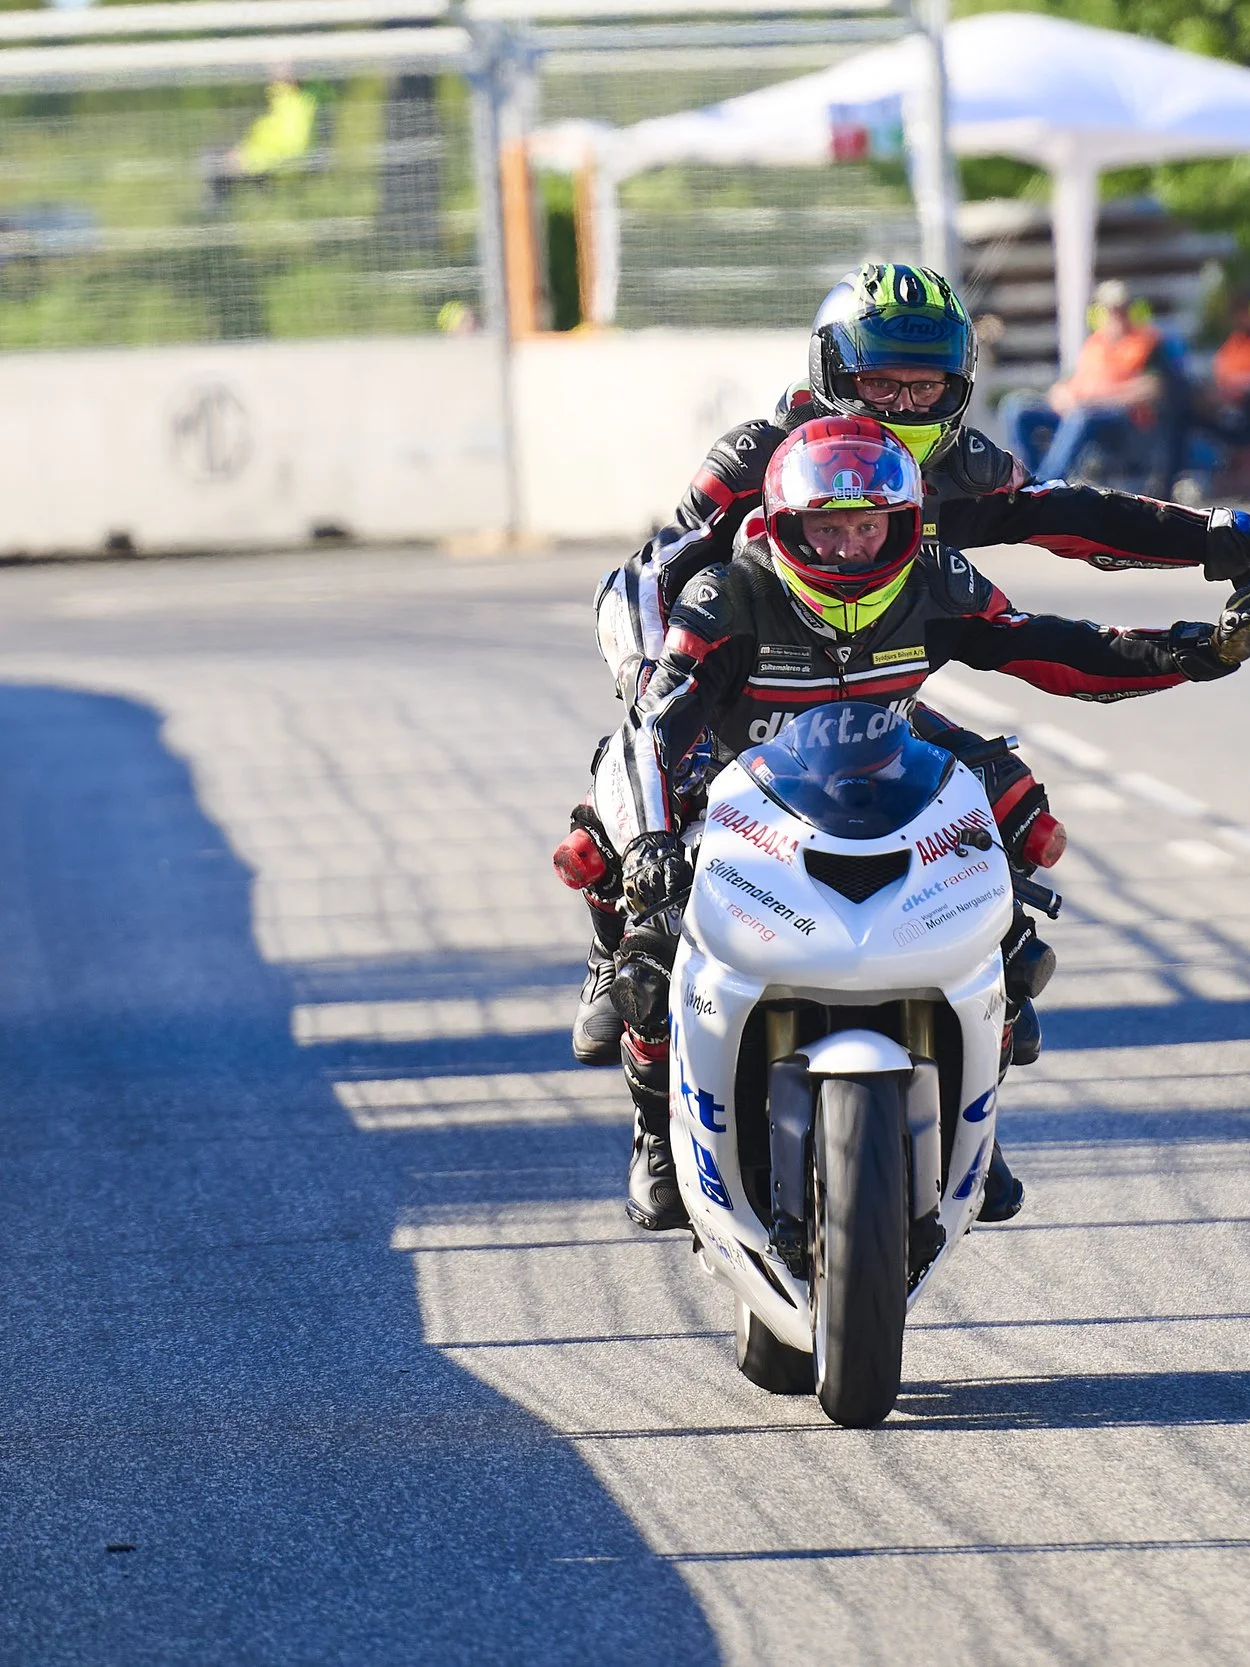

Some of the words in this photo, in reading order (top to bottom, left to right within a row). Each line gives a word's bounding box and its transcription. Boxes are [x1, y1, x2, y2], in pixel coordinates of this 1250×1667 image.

[902, 881, 944, 912] dkkt
[943, 861, 989, 889] racing
[726, 902, 776, 942] racing
[925, 909, 957, 930] Morten
[684, 983, 717, 1016] Ninja
